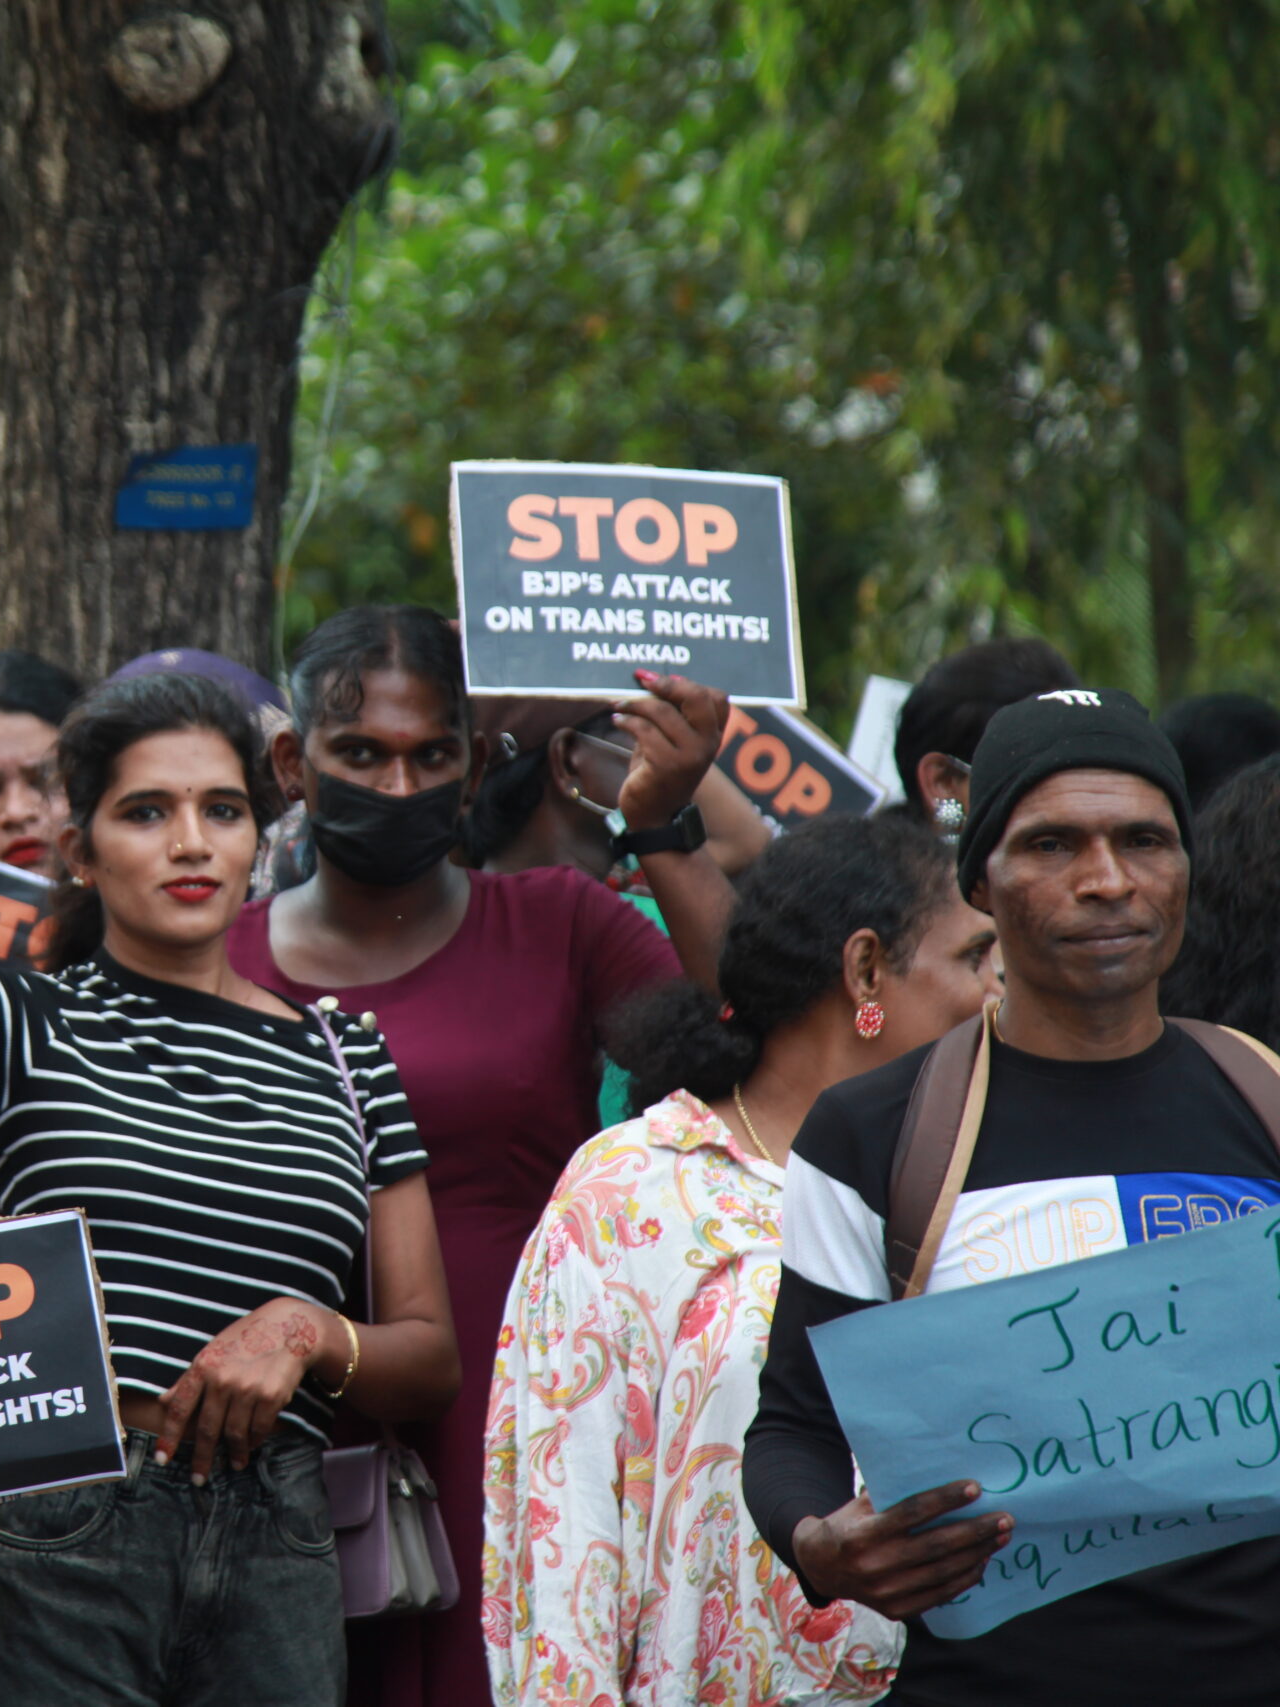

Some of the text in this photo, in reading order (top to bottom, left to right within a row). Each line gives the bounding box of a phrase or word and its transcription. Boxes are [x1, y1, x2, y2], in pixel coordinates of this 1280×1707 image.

[506, 493, 739, 567] STOP
[521, 570, 732, 604] BJP's ATTACK
[485, 606, 770, 642] ON TRANS RIGHTS!
[572, 642, 691, 665] PALAKKAD
[1007, 1284, 1187, 1374] Jai
